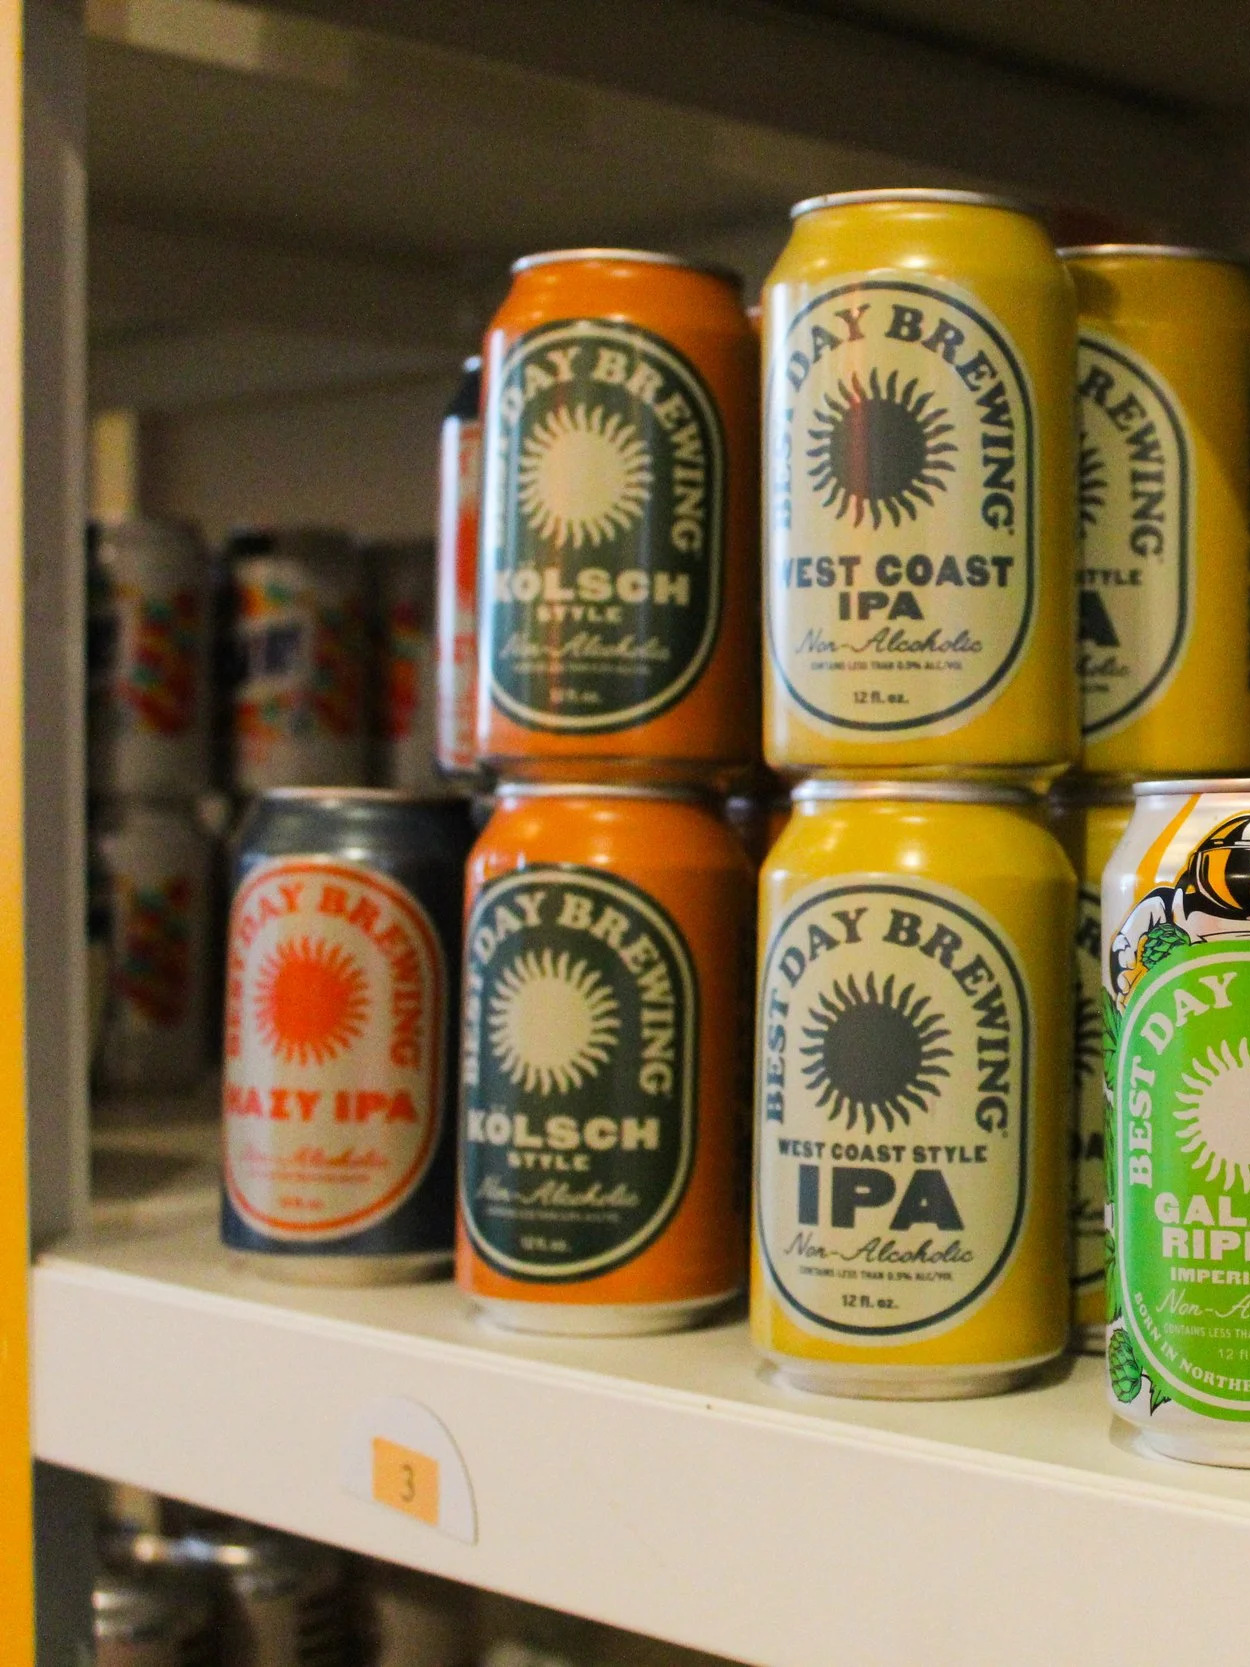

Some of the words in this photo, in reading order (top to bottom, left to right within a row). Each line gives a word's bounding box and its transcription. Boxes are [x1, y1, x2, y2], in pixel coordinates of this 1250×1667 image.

[786, 303, 871, 392] DAY
[885, 304, 1016, 530] BREWING
[501, 347, 582, 427] DAY
[591, 350, 705, 551] BREWING
[1078, 364, 1164, 558] REWING
[875, 554, 1015, 588] COAST
[838, 590, 925, 621] IPA
[795, 626, 984, 655] Non-Alcoholic
[853, 690, 869, 705] 12
[239, 881, 304, 948] DAY
[317, 885, 423, 1070] BREWING
[472, 891, 547, 965] DAY
[555, 892, 675, 1096] BREWING
[767, 989, 789, 1125] BEST
[779, 907, 869, 988] DAY
[882, 908, 1011, 1133] BREWING
[1140, 972, 1238, 1056] DAY
[334, 1087, 418, 1124] IPA
[1129, 1056, 1156, 1189] BEST
[506, 1152, 591, 1172] STYLE
[778, 1138, 825, 1160] WEST
[831, 1142, 907, 1163] COAST
[912, 1145, 988, 1164] STYLE
[797, 1163, 965, 1231] IPA
[783, 1231, 975, 1264] Non-Alcoholic
[842, 1294, 856, 1307] 12
[1134, 1292, 1162, 1343] BORN
[1160, 1341, 1178, 1363] IN
[1163, 1325, 1205, 1338] CONTAINS
[1208, 1327, 1238, 1339] LESS
[1218, 1349, 1234, 1360] 12
[400, 1463, 416, 1503] 3
